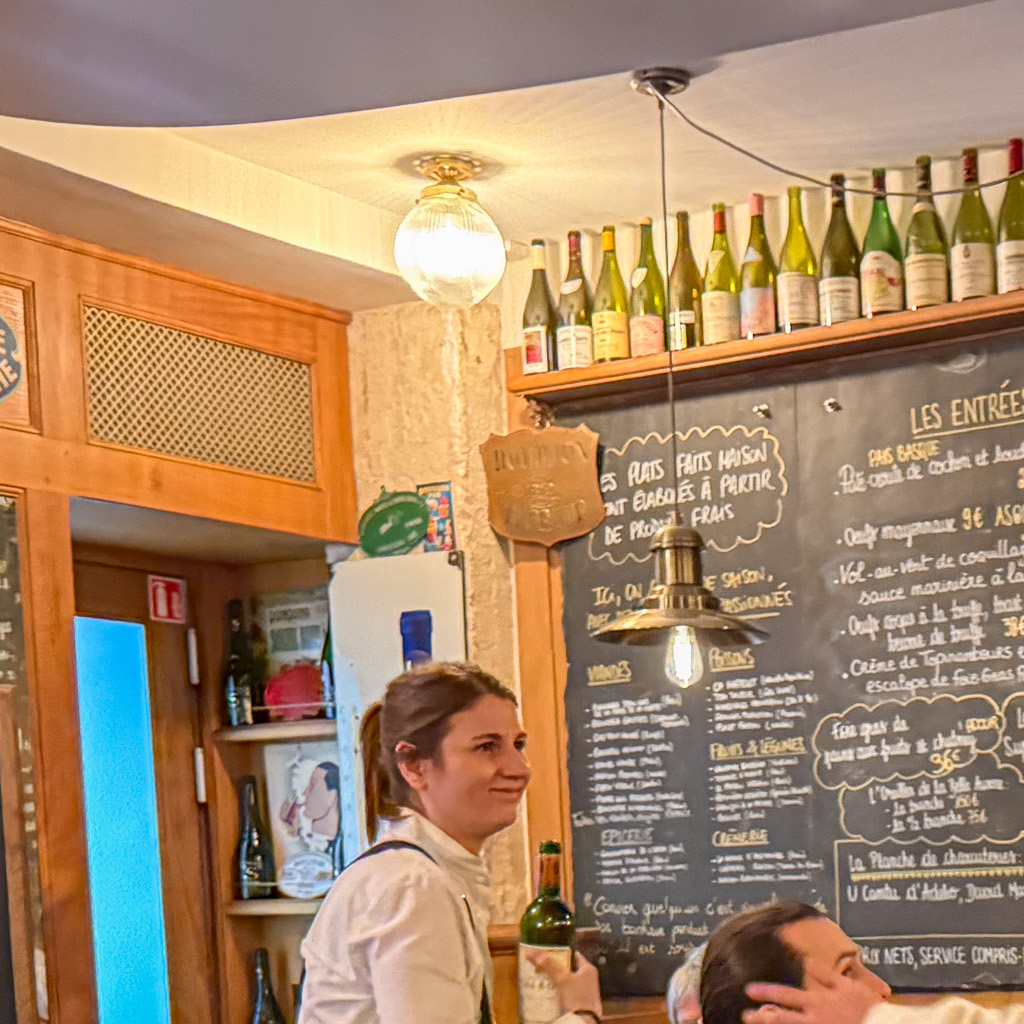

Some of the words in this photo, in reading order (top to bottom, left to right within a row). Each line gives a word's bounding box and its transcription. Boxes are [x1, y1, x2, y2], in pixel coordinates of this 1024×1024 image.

[911, 403, 942, 434] LES
[601, 472, 617, 492] ES
[628, 459, 665, 487] PLATS
[720, 469, 776, 498] PARTIR
[962, 507, 984, 530] 9€
[605, 526, 623, 545] DE
[936, 553, 955, 570] de
[625, 583, 642, 600] ON
[859, 587, 906, 606] sauce
[899, 655, 919, 670] de
[921, 947, 966, 964] SERVICE
